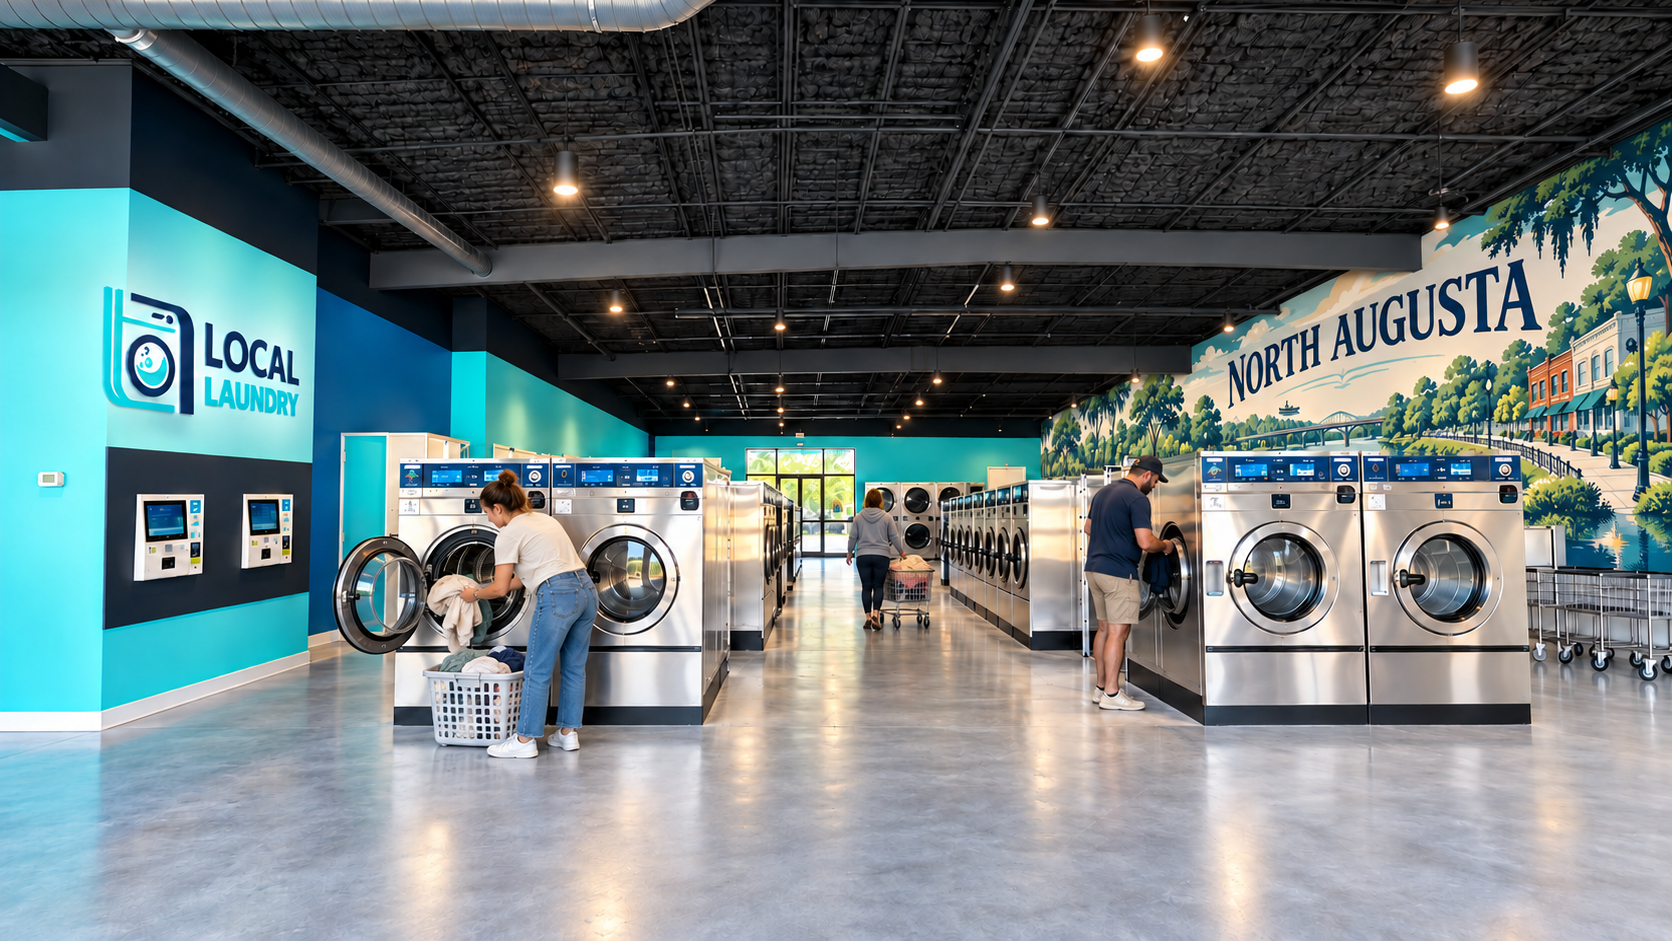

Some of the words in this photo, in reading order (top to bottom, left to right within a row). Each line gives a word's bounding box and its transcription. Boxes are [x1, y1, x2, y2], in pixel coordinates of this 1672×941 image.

[204, 322, 300, 386] LOCAL
[1227, 323, 1321, 408] NORTH
[1330, 258, 1542, 362] AUGUSTA
[204, 376, 300, 417] LAUNDRY
